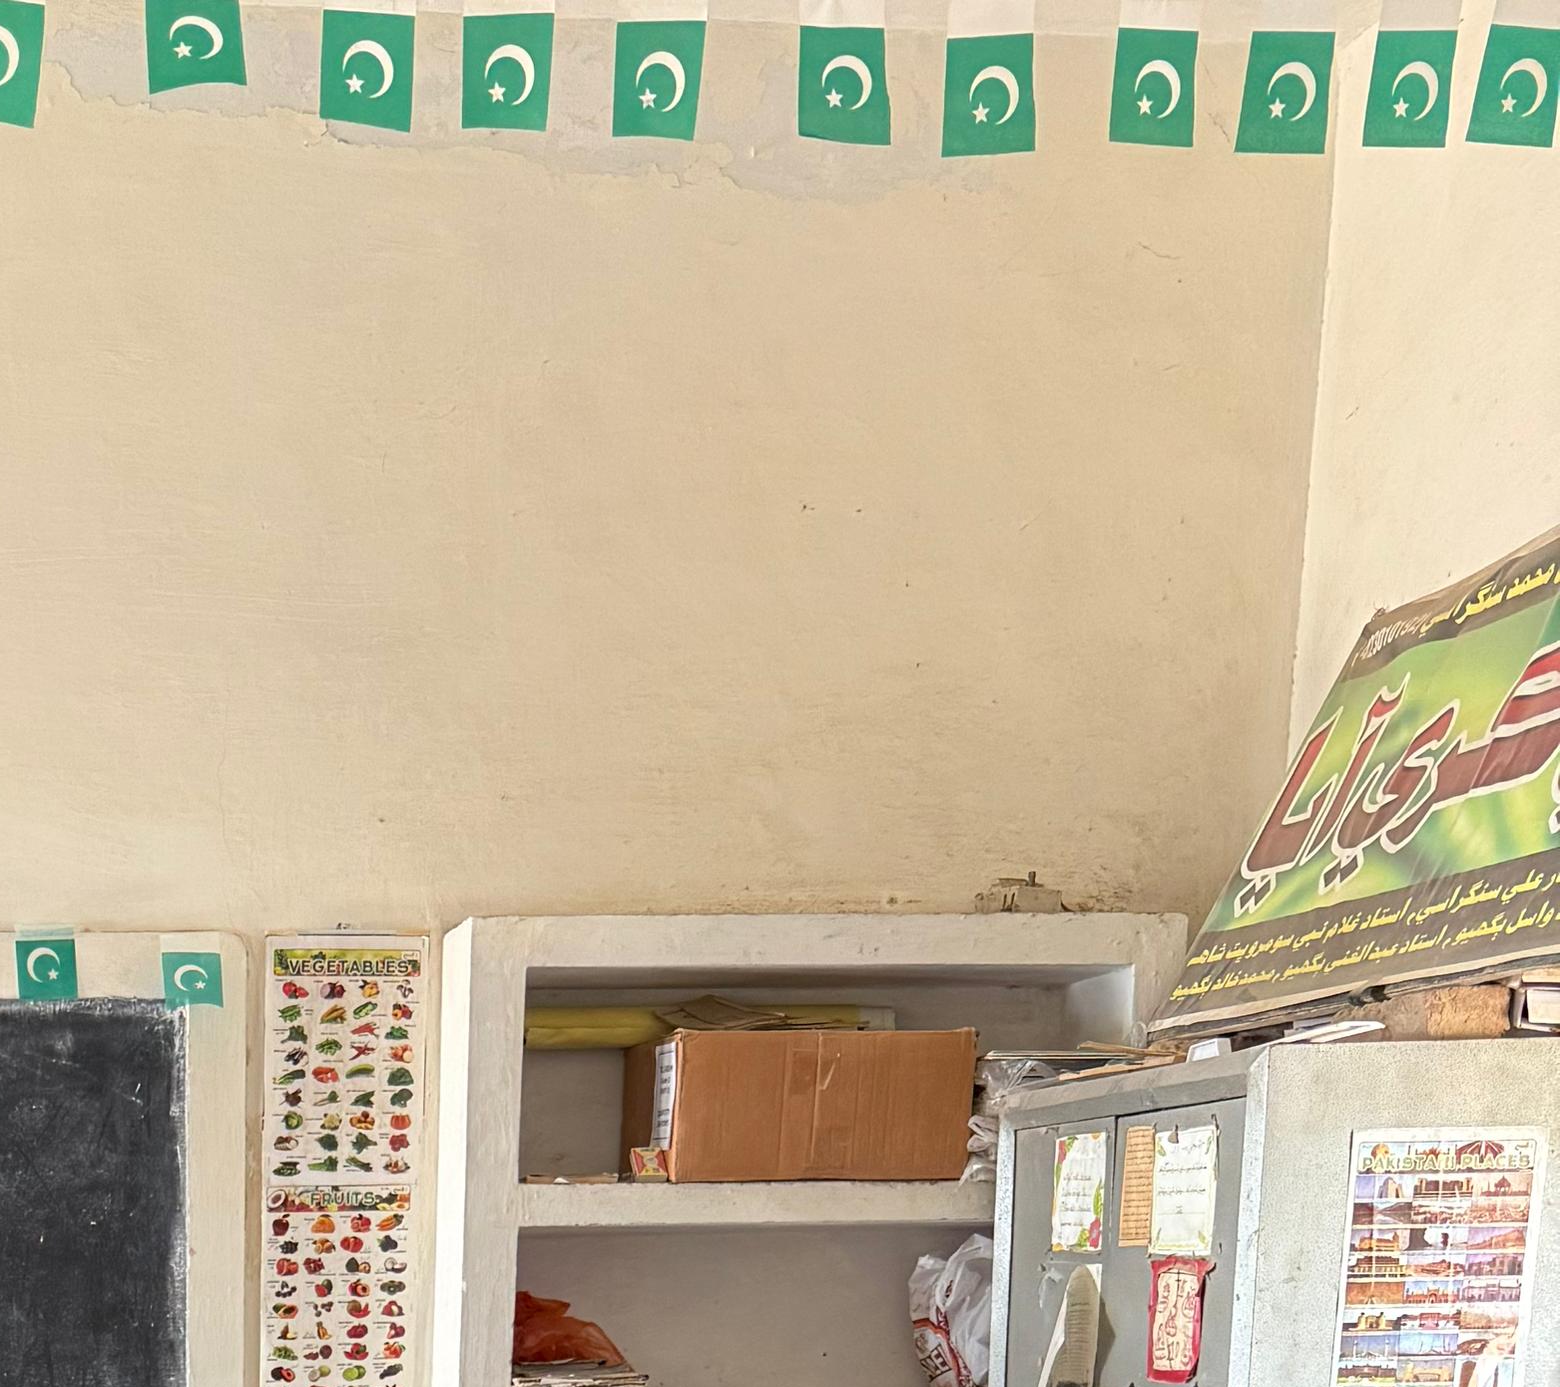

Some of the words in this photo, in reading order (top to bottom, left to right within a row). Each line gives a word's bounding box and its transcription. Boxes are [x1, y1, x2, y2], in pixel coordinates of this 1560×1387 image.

[1506, 563, 1556, 600] محمد
[1501, 869, 1545, 905] علي
[1326, 912, 1362, 942] غلام
[1360, 897, 1412, 930] استاد
[1293, 921, 1328, 951] نبي
[1398, 924, 1448, 954] استاد
[288, 960, 409, 974] VEGETABLES
[1461, 1154, 1531, 1170] PLACES
[310, 1191, 376, 1206] FRUITS
